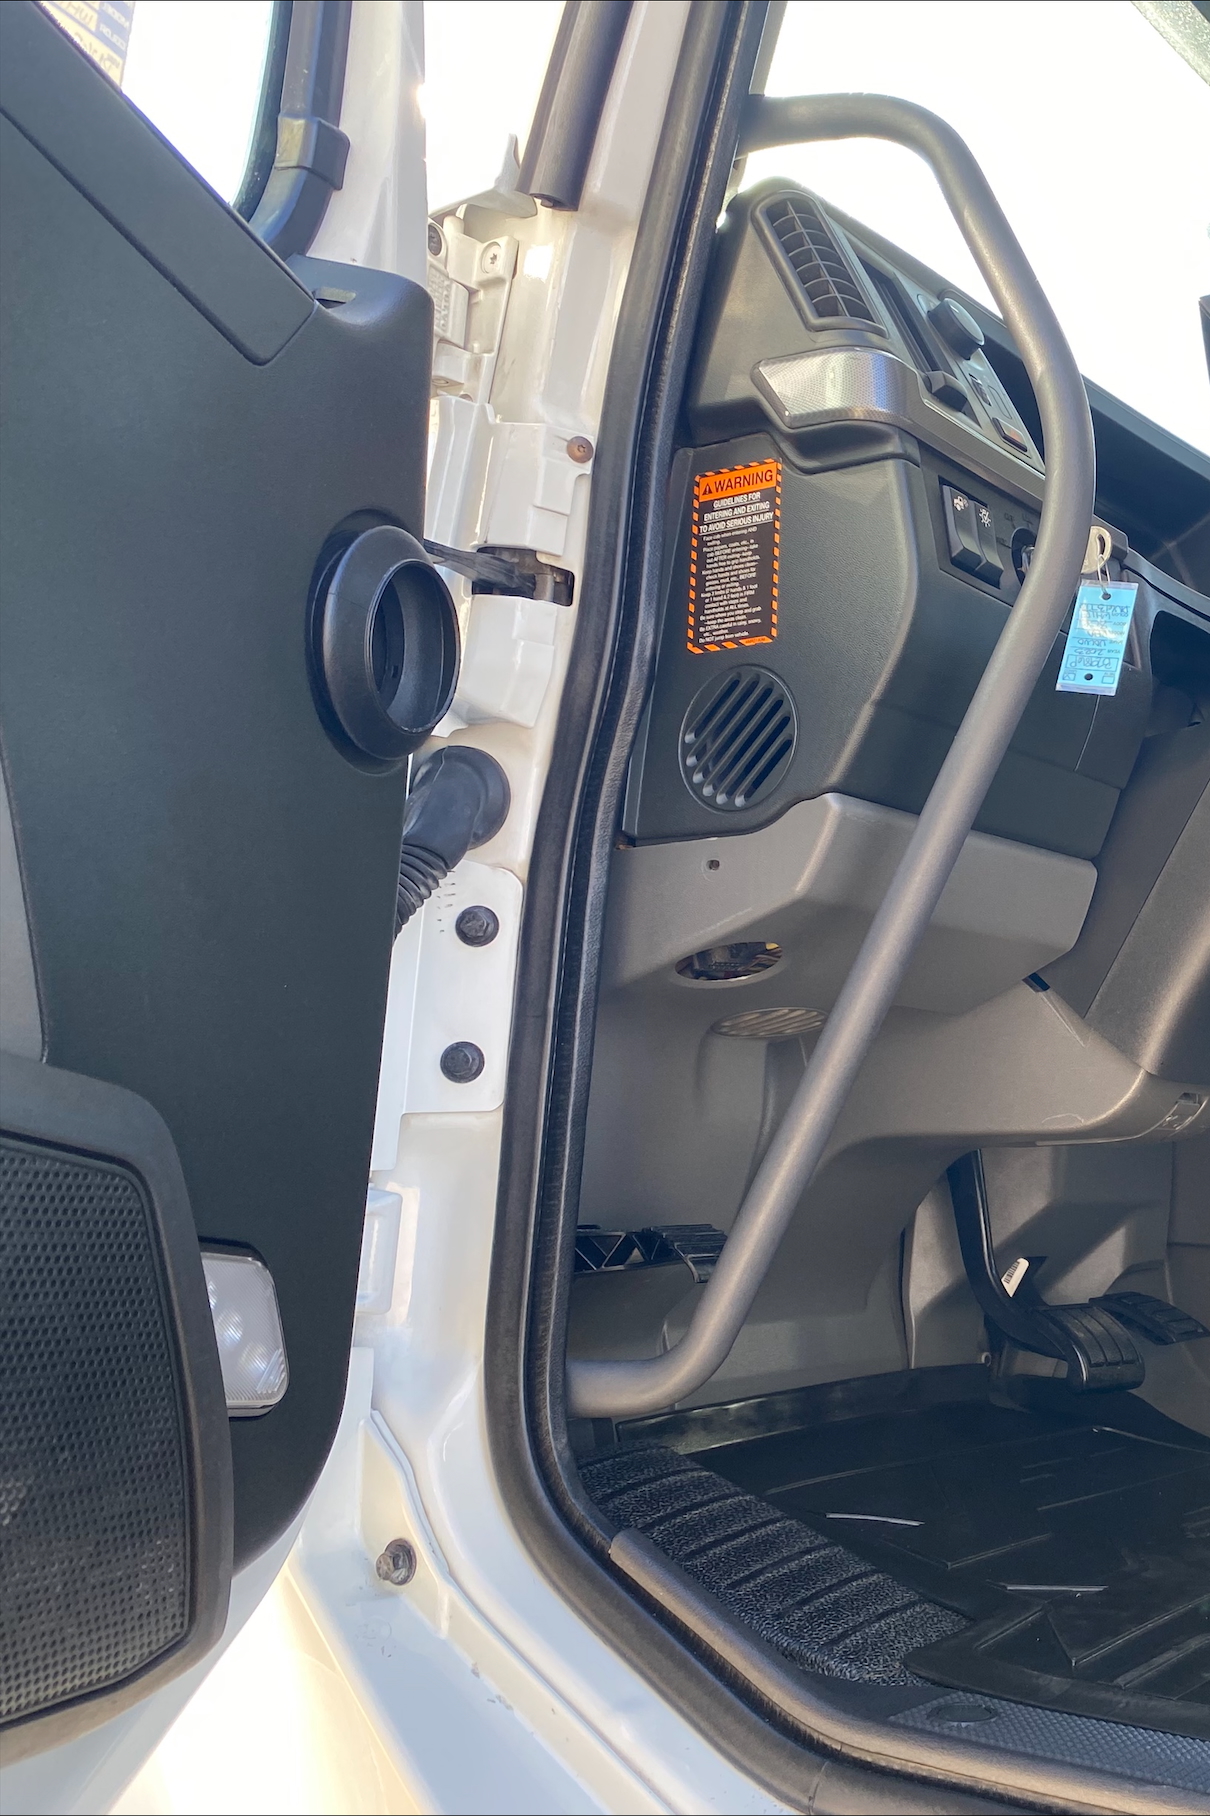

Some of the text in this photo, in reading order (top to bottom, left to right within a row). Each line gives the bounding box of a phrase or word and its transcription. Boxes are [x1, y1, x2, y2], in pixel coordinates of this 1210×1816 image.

[714, 469, 774, 492] WARNING
[713, 492, 761, 508] GUIDELINES FOR
[704, 502, 770, 522] ENTERING AND EXITING
[700, 512, 774, 533] TO AVOID SERIOUS INJURY
